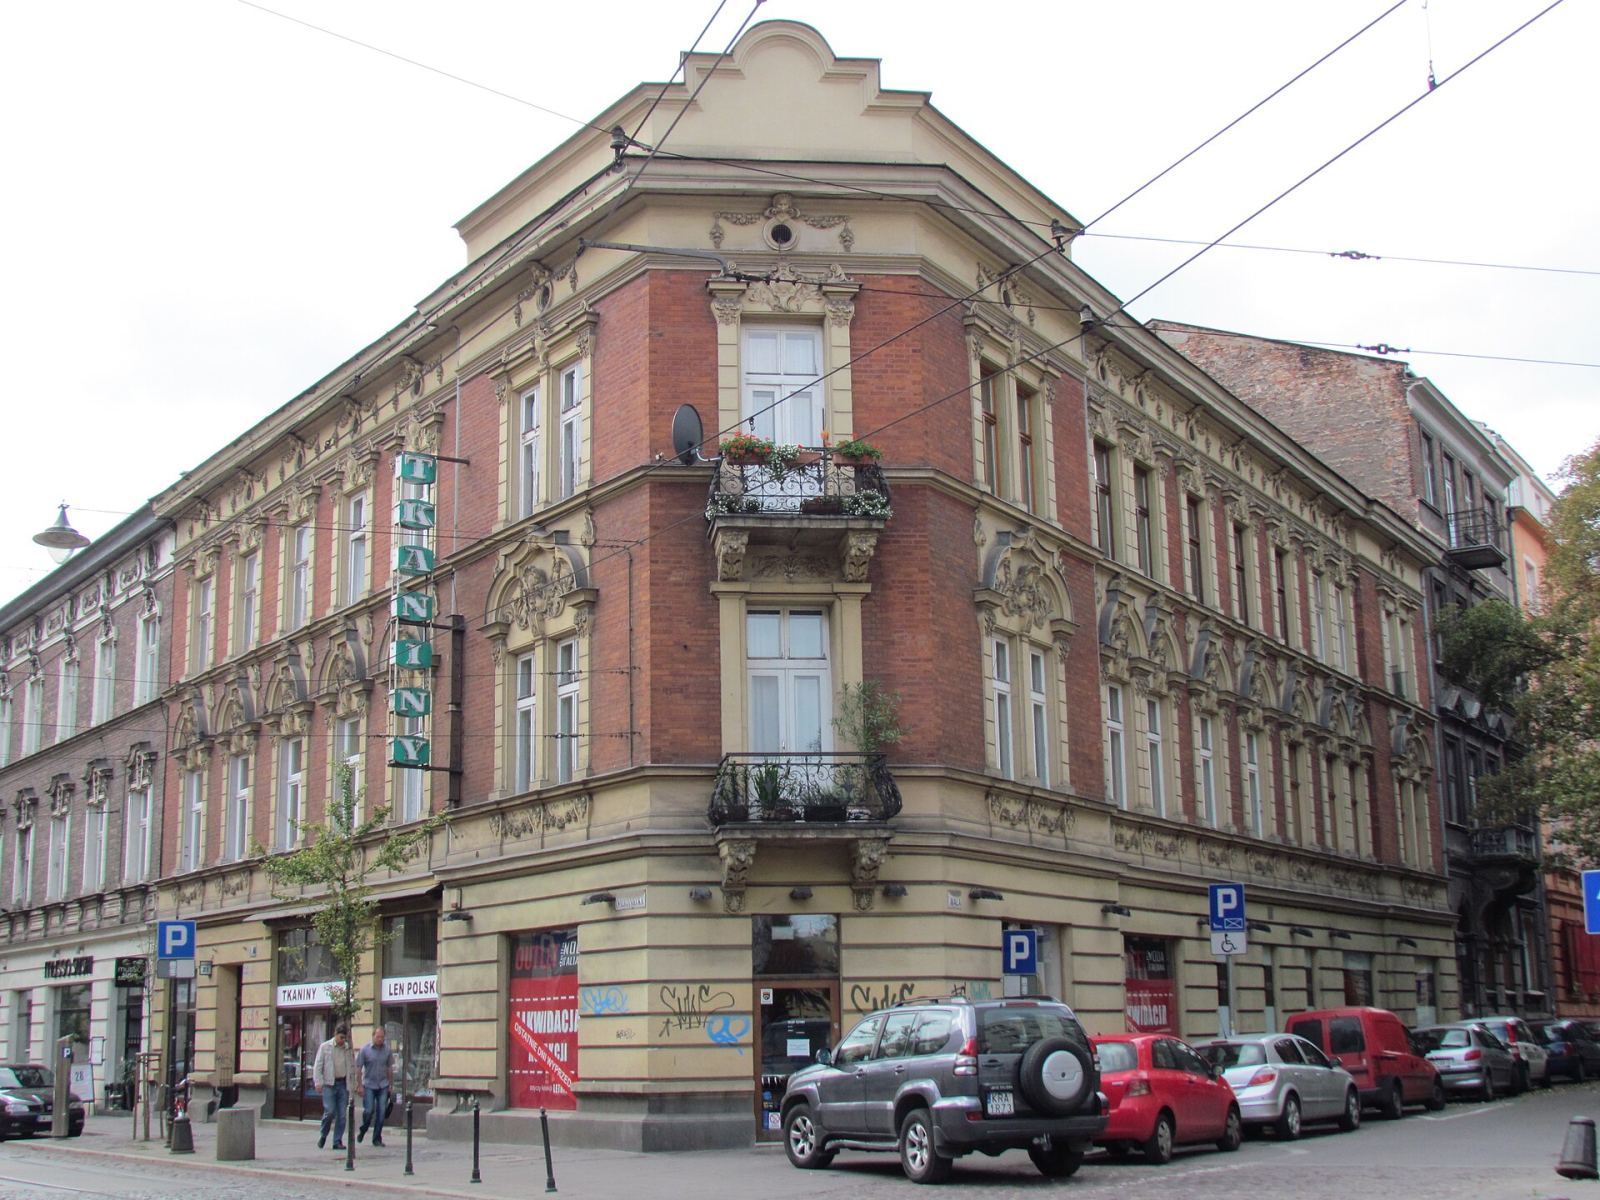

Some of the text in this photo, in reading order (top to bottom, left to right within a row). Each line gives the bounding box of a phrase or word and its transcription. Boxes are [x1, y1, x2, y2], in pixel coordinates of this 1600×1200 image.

[399, 455, 434, 761] TKANINY
[1216, 888, 1238, 918] P
[165, 925, 188, 954] P
[1009, 935, 1030, 969] P
[282, 988, 317, 1001] TKANINY
[388, 980, 436, 996] LEN POLSK
[64, 1047, 71, 1058] P
